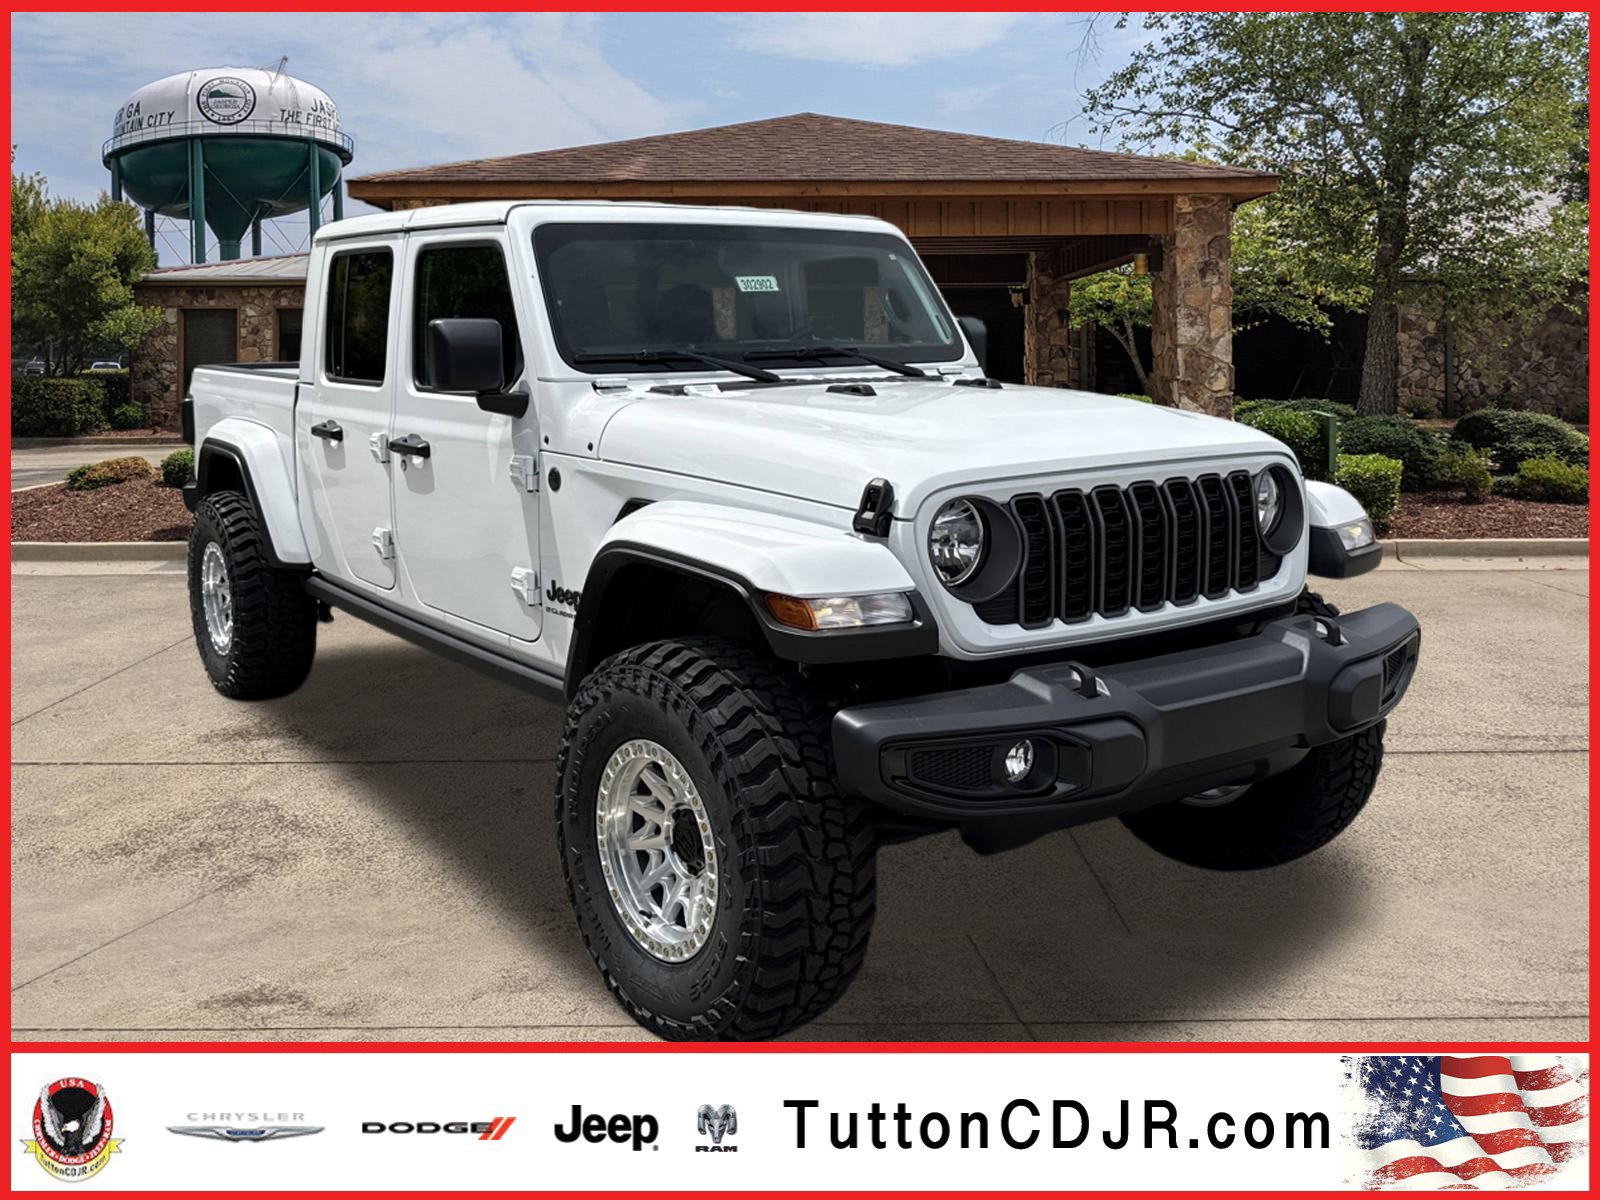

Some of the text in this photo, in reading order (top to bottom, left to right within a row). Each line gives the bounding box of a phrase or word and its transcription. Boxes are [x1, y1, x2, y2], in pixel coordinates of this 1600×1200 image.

[126, 101, 141, 119] GA
[147, 110, 176, 127] CITY
[280, 109, 302, 124] THE
[307, 112, 333, 130] FIRST
[546, 579, 581, 612] Jeep
